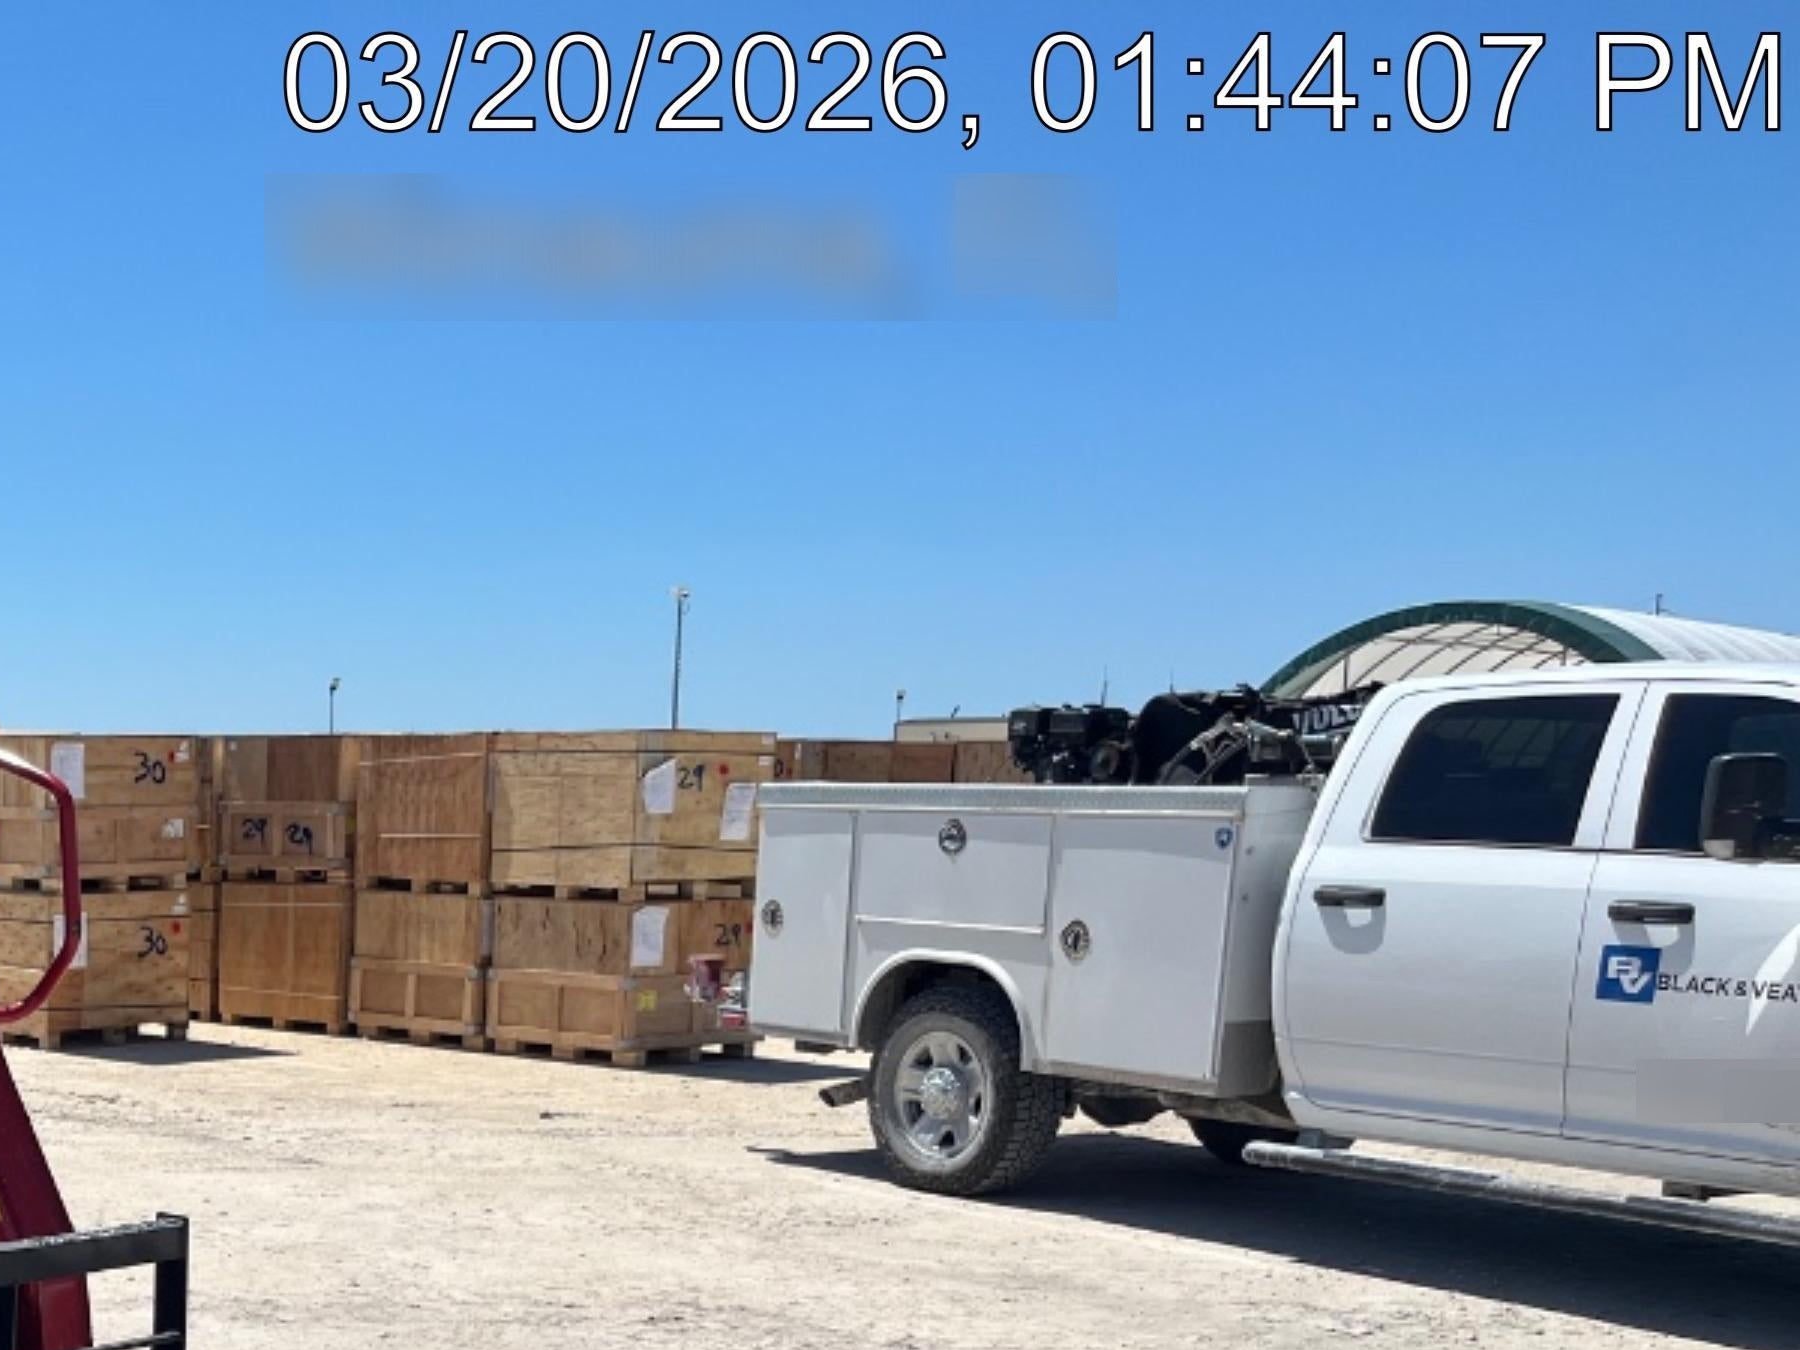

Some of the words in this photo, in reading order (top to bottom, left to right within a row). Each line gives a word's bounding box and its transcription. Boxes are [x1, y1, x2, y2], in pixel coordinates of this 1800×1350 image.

[134, 751, 167, 785] 30
[137, 925, 168, 958] 30
[1658, 974, 1730, 997] BLACK
[1734, 980, 1748, 997] &
[1751, 979, 1800, 1003] VEA
